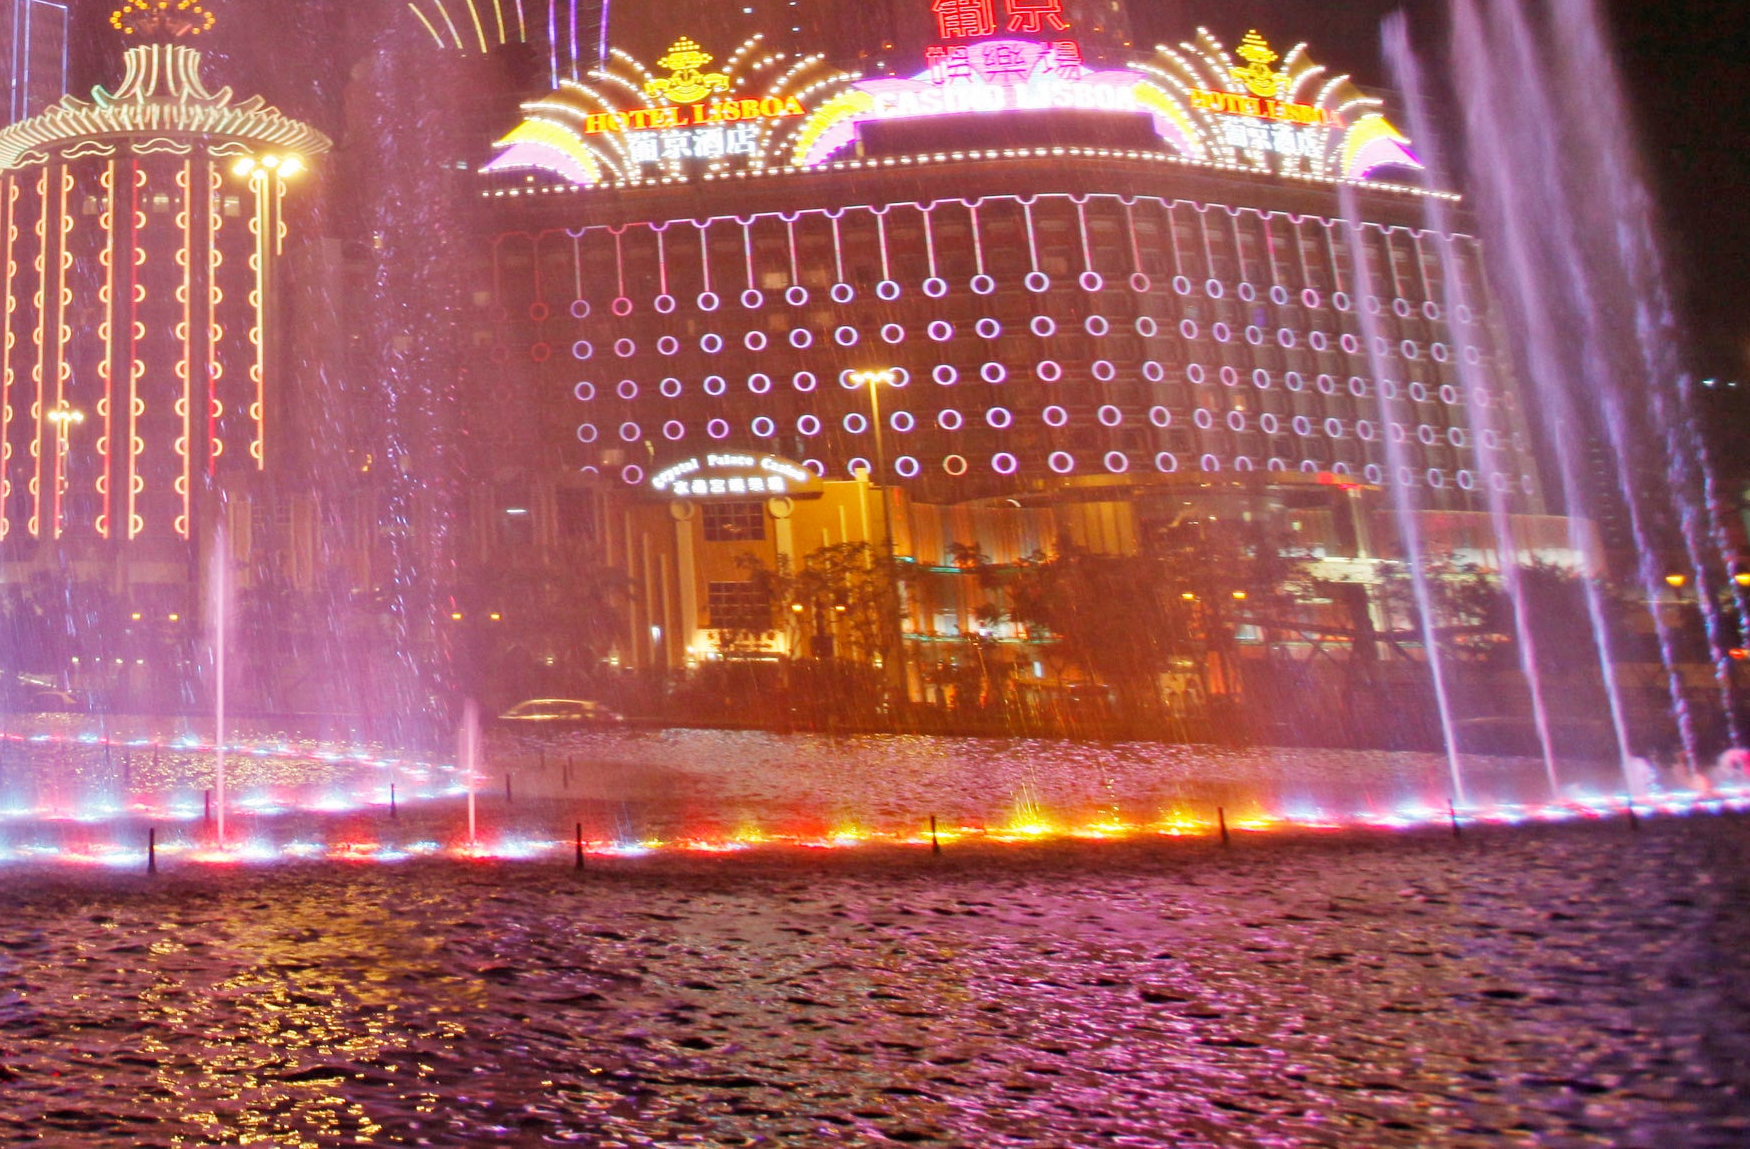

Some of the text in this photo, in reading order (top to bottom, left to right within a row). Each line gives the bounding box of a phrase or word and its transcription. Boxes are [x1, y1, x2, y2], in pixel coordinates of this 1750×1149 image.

[585, 95, 806, 133] HOTEL LISBOA
[874, 80, 1136, 118] CASINO LISBOA
[1189, 89, 1268, 117] HOTEL
